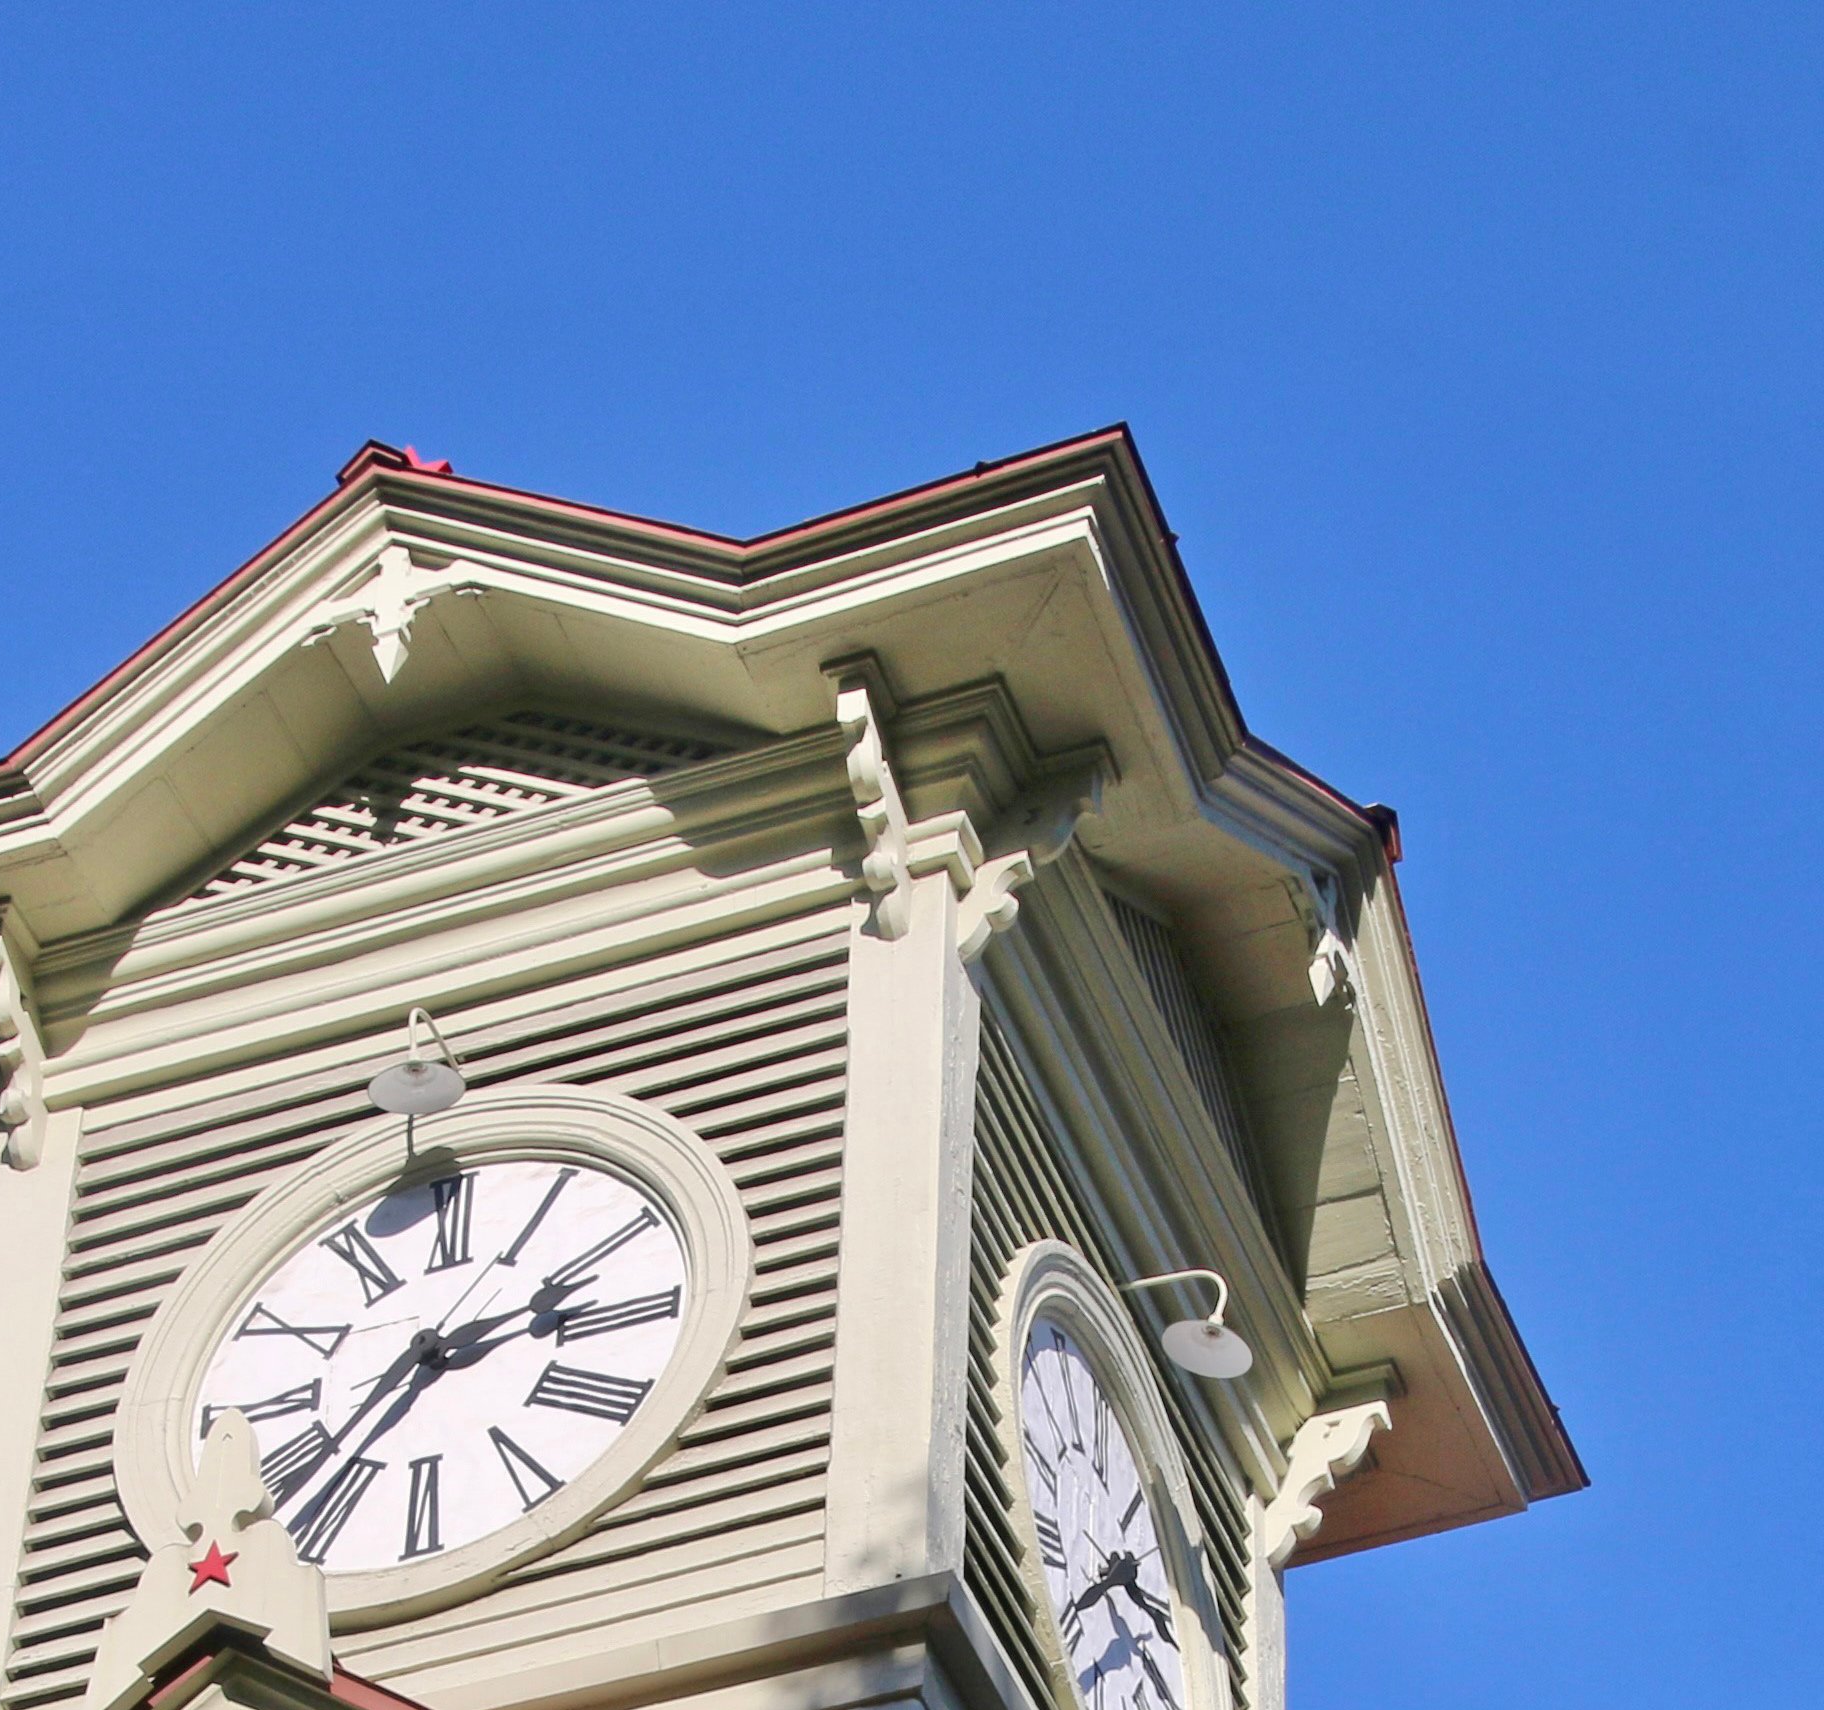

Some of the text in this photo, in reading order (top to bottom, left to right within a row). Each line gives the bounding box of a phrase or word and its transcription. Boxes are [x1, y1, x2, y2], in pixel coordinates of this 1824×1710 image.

[320, 1219, 408, 1308] XI
[424, 1171, 480, 1274] XII
[542, 1205, 661, 1289] II
[232, 1303, 353, 1358] X
[555, 1284, 682, 1347] III
[399, 1453, 444, 1561] VI
[487, 1427, 566, 1513] V
